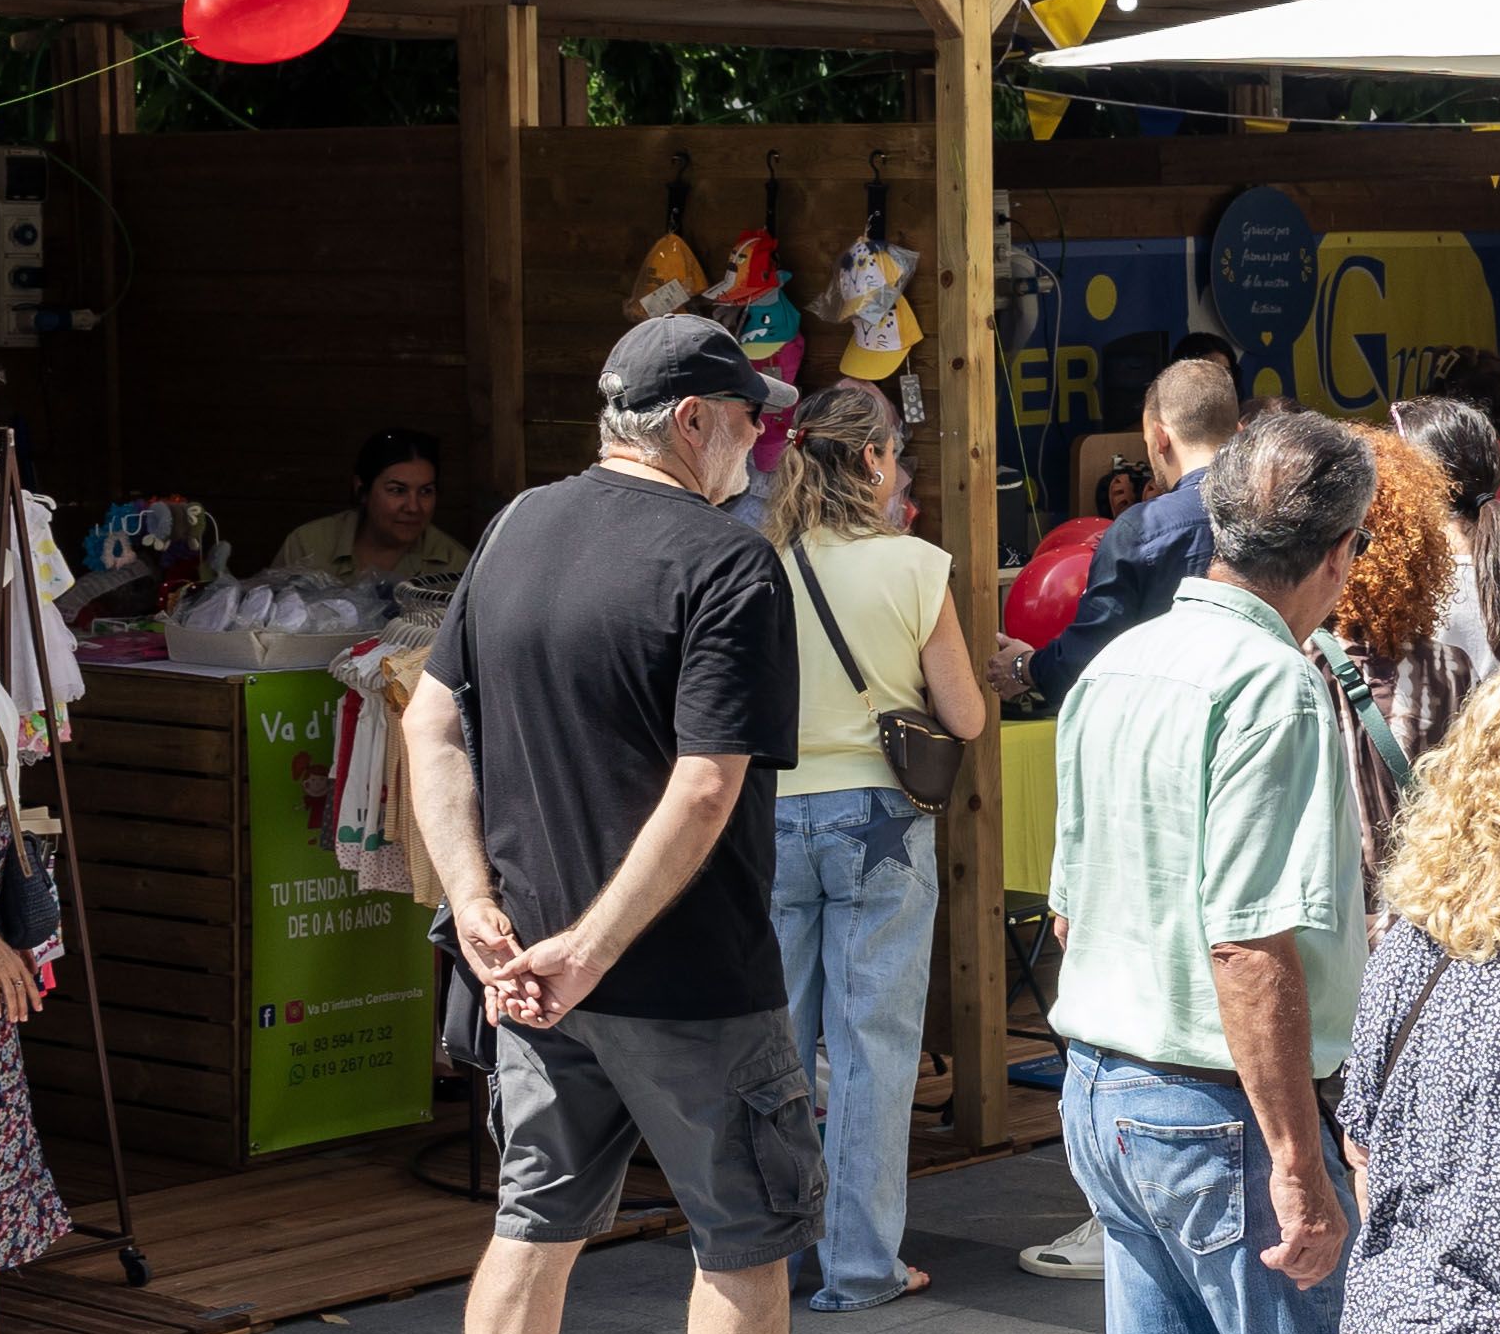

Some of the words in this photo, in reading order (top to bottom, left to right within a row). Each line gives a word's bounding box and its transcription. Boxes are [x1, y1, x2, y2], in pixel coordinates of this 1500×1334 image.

[260, 710, 296, 744] Va
[270, 882, 290, 907] TU
[294, 874, 348, 904] TIENDA
[288, 914, 308, 939] DE
[324, 911, 335, 935] A
[339, 908, 353, 932] 16
[355, 899, 392, 929] AÑOS
